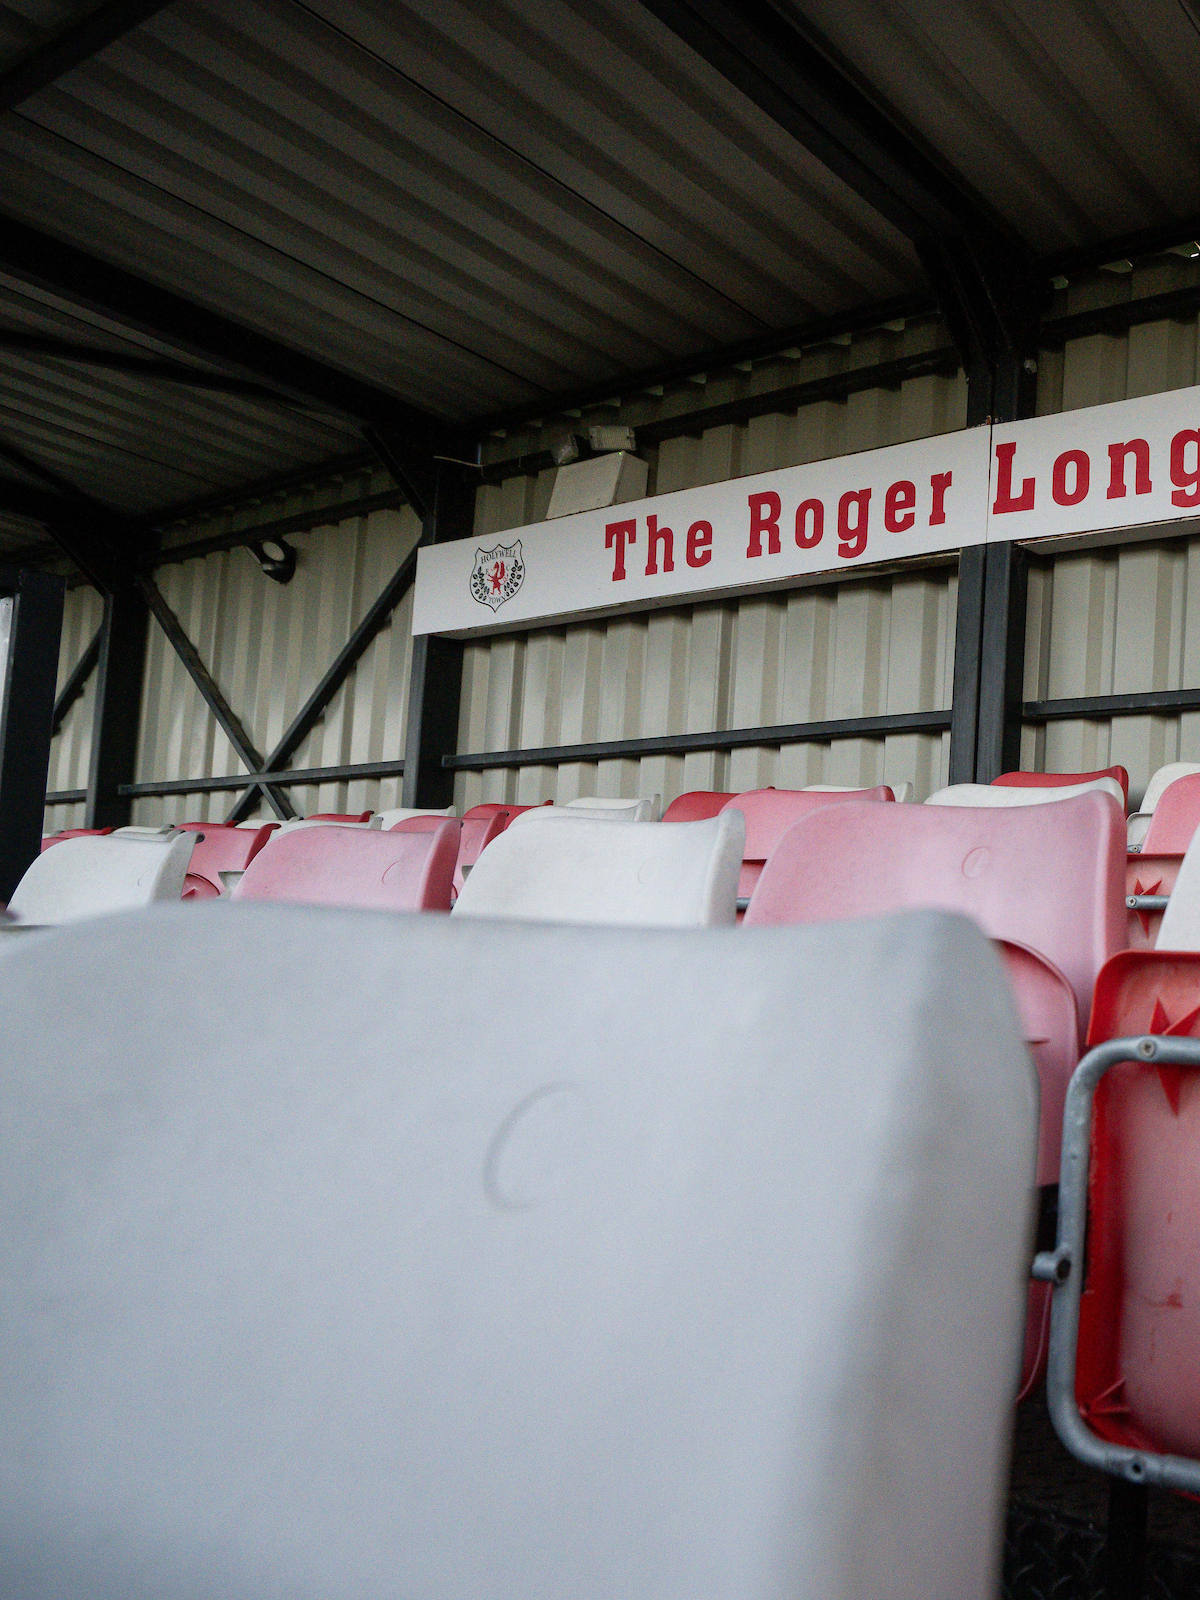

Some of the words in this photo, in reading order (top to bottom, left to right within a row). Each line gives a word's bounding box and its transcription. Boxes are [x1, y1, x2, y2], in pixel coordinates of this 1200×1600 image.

[480, 549, 517, 564] HOLYWELL
[604, 514, 713, 582] The
[746, 470, 953, 559] Roger
